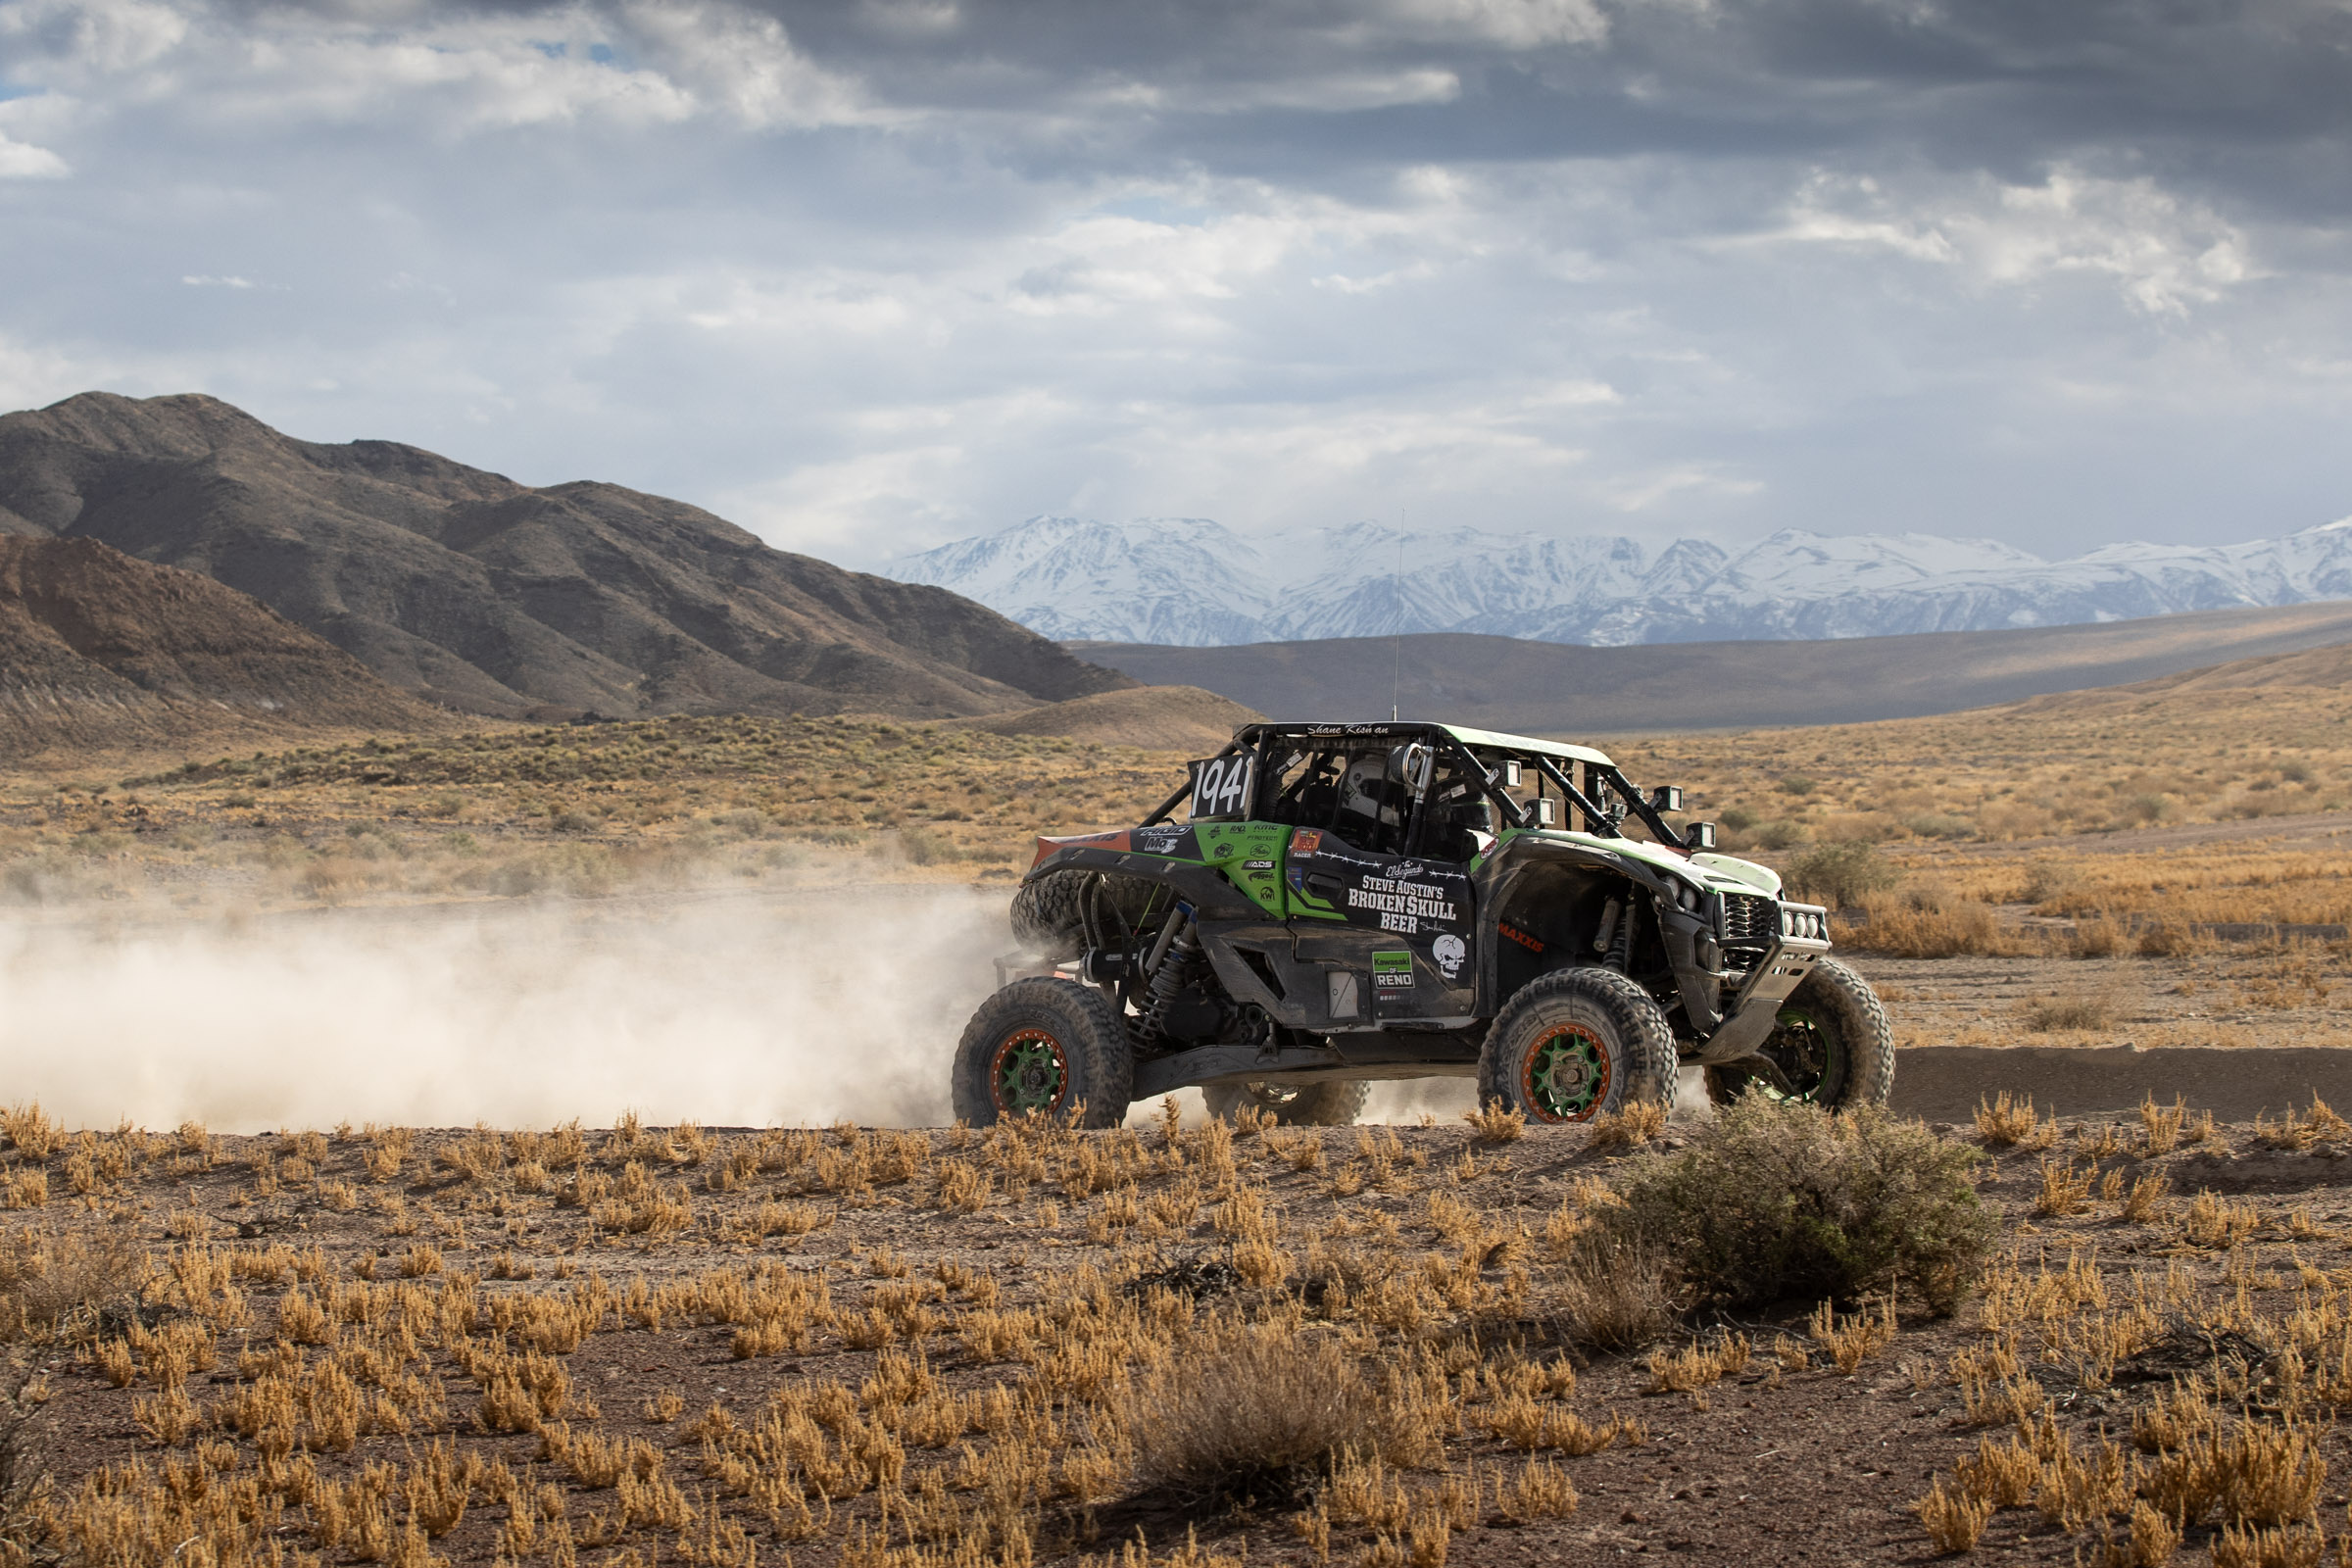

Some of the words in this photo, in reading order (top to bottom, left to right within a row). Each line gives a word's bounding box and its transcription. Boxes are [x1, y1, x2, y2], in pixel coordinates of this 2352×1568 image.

[1307, 723, 1342, 735] Shane
[1191, 755, 1254, 816] 1941
[1362, 875, 1396, 893] STEVE
[1396, 879, 1445, 900] AUSTIN'S
[1348, 888, 1406, 913] BROKEN
[1405, 896, 1456, 920] SKULL
[1380, 912, 1418, 934] BEER
[1497, 922, 1544, 953] MAXXIS
[1376, 975, 1412, 986] RENO
